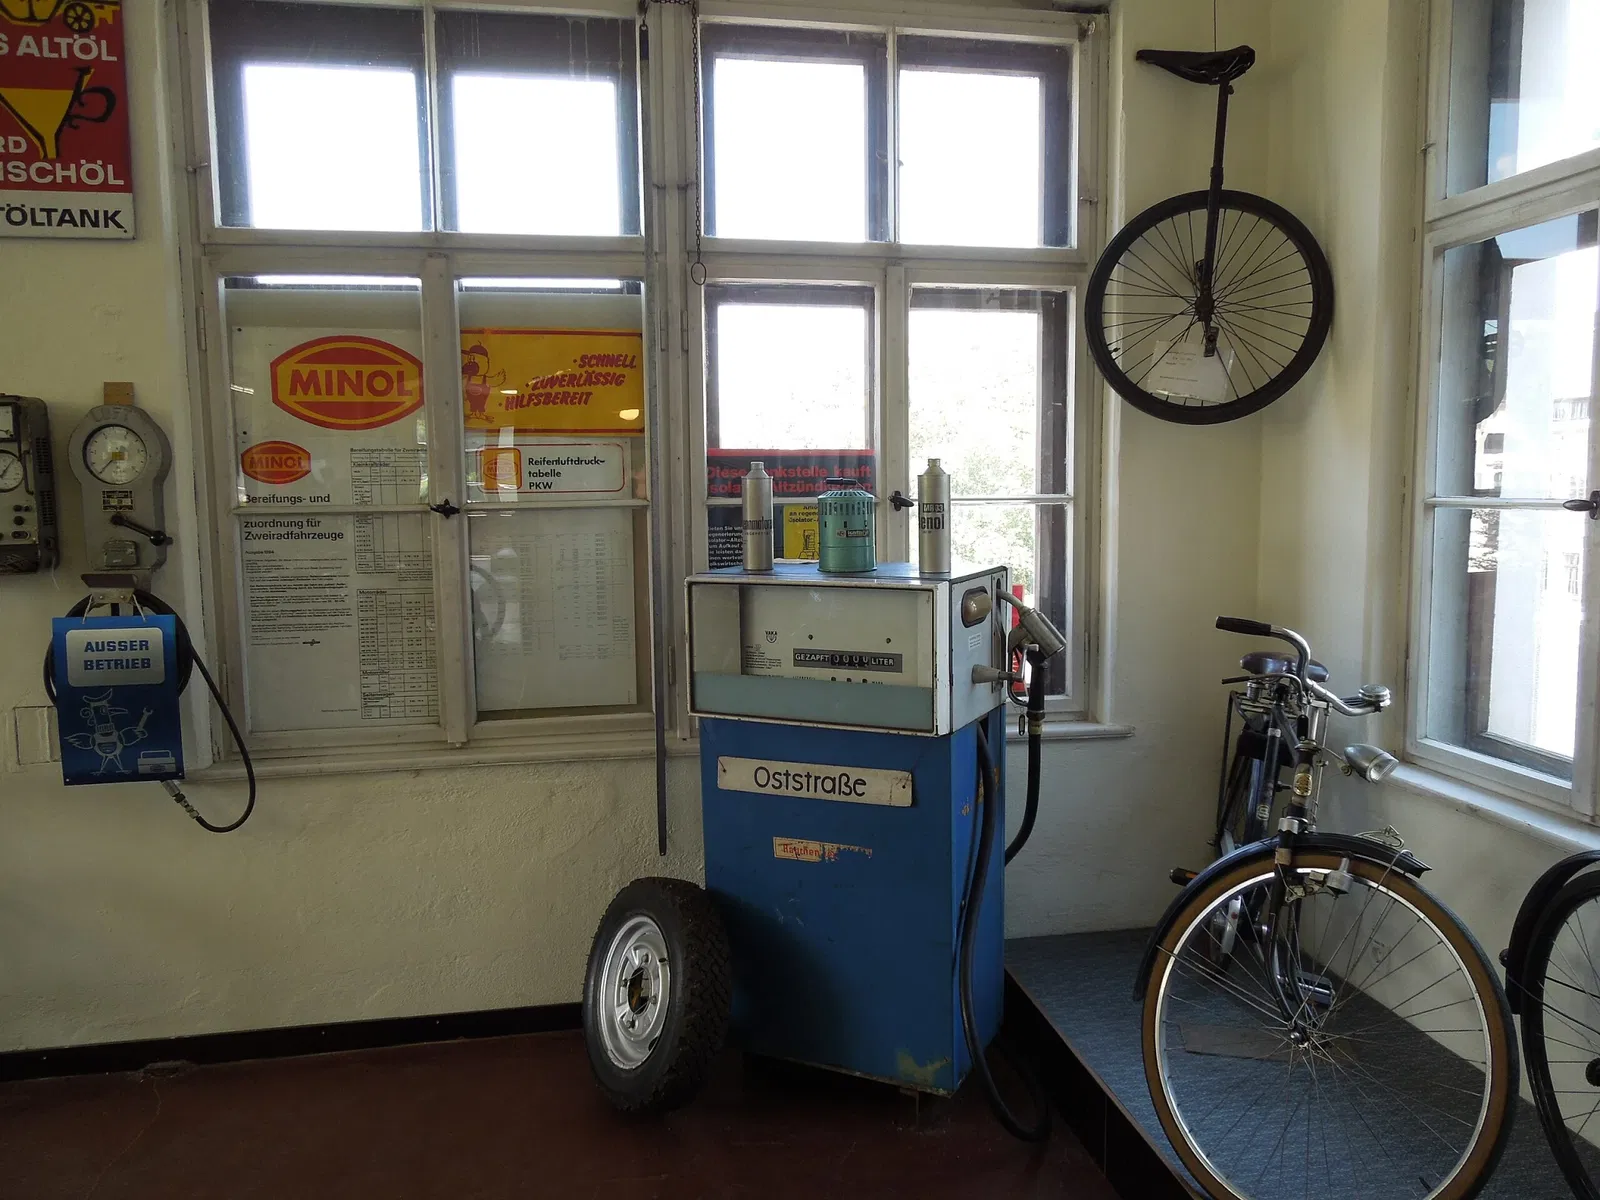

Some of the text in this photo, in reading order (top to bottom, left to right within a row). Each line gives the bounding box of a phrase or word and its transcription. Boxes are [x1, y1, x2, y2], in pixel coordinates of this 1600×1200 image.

[16, 34, 118, 62] ALTÖL
[0, 159, 124, 186] SCHÖL
[578, 353, 637, 369] SCHNELL
[288, 369, 413, 397] MINOL
[531, 370, 626, 391] ZUVERLÄSSIG
[504, 391, 593, 411] HILFSBEREIT
[248, 455, 305, 470] MINOL
[528, 456, 605, 466] Reifenluftdruck-
[528, 469, 562, 478] tabelle
[834, 464, 872, 478] kauft
[529, 481, 553, 490] PKW
[245, 493, 331, 505] Bereifungs- und
[243, 518, 322, 530] zuordnung für
[244, 530, 344, 541] Zweiradfahrzeuge
[84, 639, 149, 653] AUSSER
[83, 658, 151, 671] BETRIEB
[795, 653, 829, 662] GEZAPFT
[871, 657, 894, 666] LITER
[753, 765, 867, 797] Oststraße
